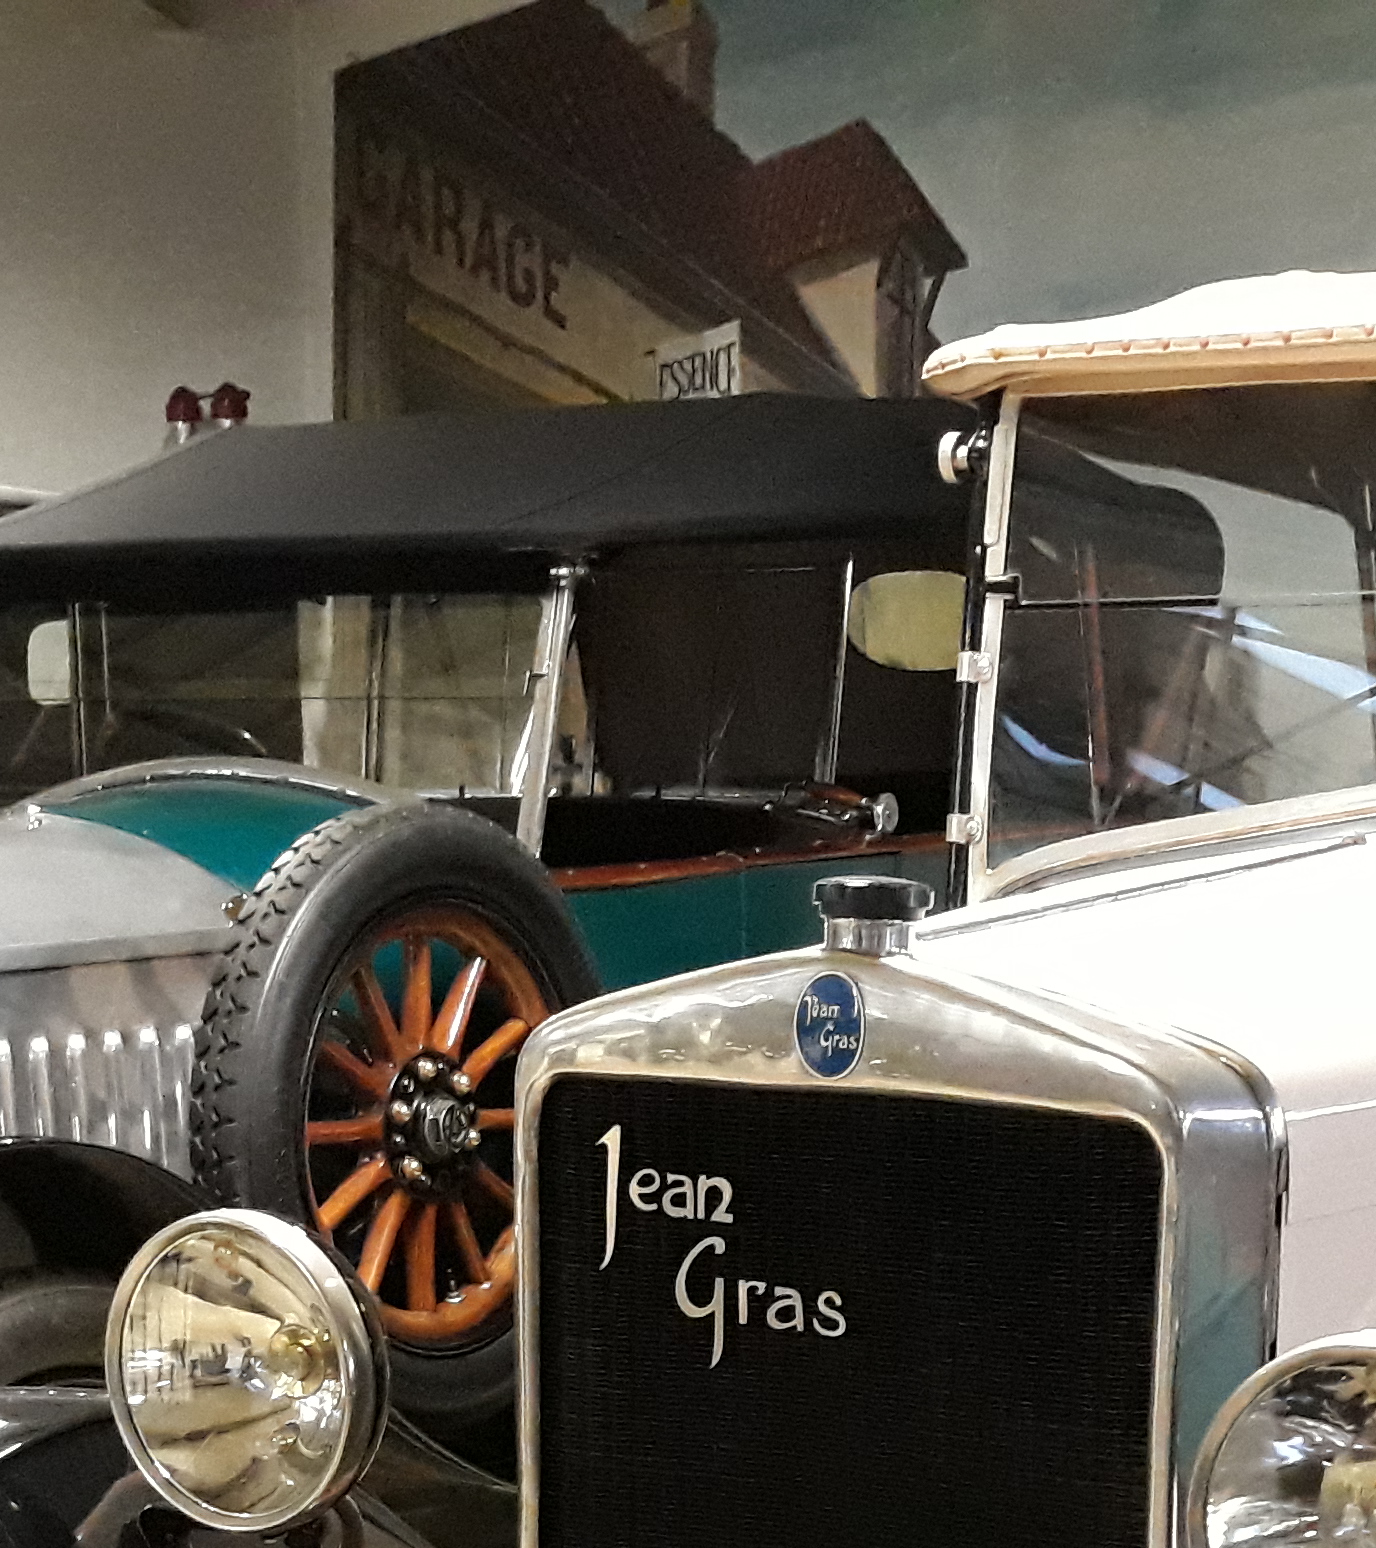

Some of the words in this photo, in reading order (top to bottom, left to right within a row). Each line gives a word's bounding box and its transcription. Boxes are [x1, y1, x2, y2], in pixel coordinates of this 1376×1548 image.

[356, 143, 568, 332] GARAGE
[658, 340, 738, 400] ESSENCE
[802, 994, 841, 1027] Jean
[819, 1022, 858, 1057] Gras
[595, 1124, 734, 1271] Jean
[674, 1235, 848, 1370] Gras
